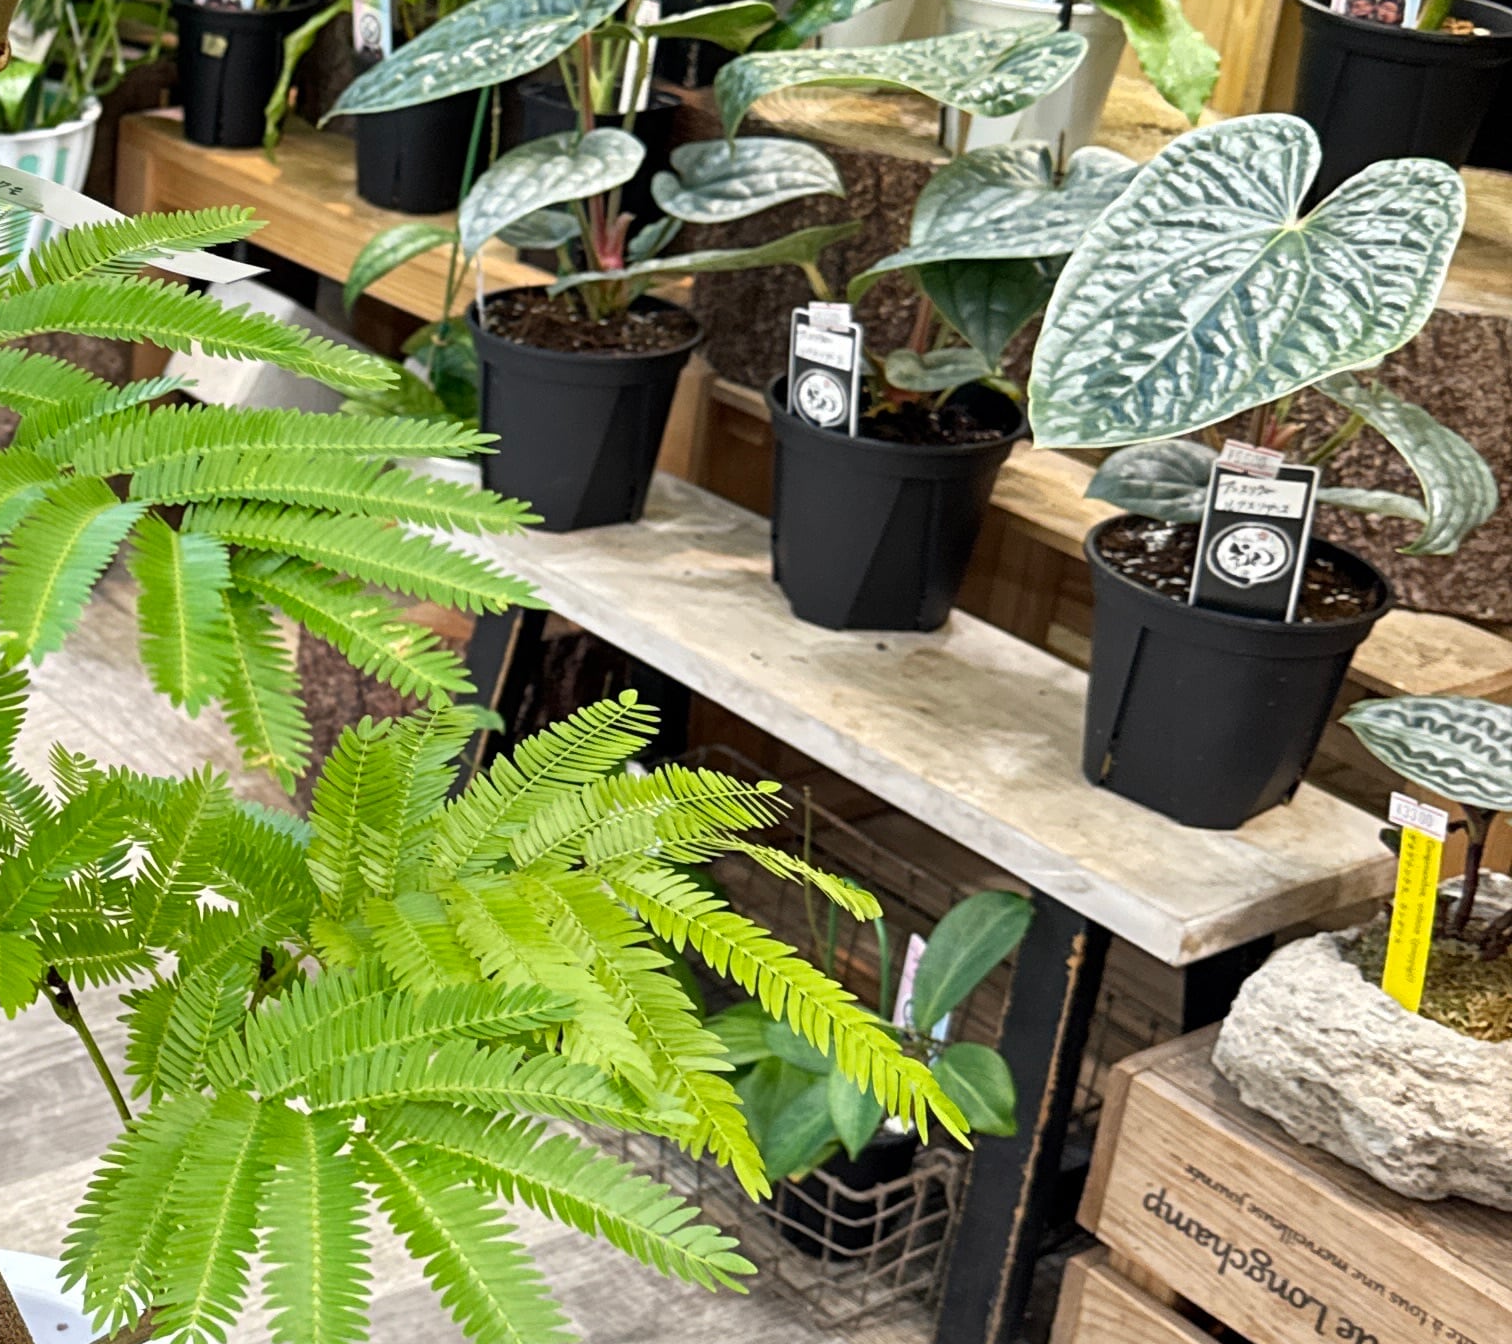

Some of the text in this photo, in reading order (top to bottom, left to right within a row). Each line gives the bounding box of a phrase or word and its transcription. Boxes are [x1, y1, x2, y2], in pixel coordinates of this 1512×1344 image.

[1143, 1188, 1328, 1336] Longchamp
[1246, 1202, 1349, 1274] merveilleuse
[1351, 1267, 1386, 1297] une
[1389, 1291, 1429, 1326] tous
